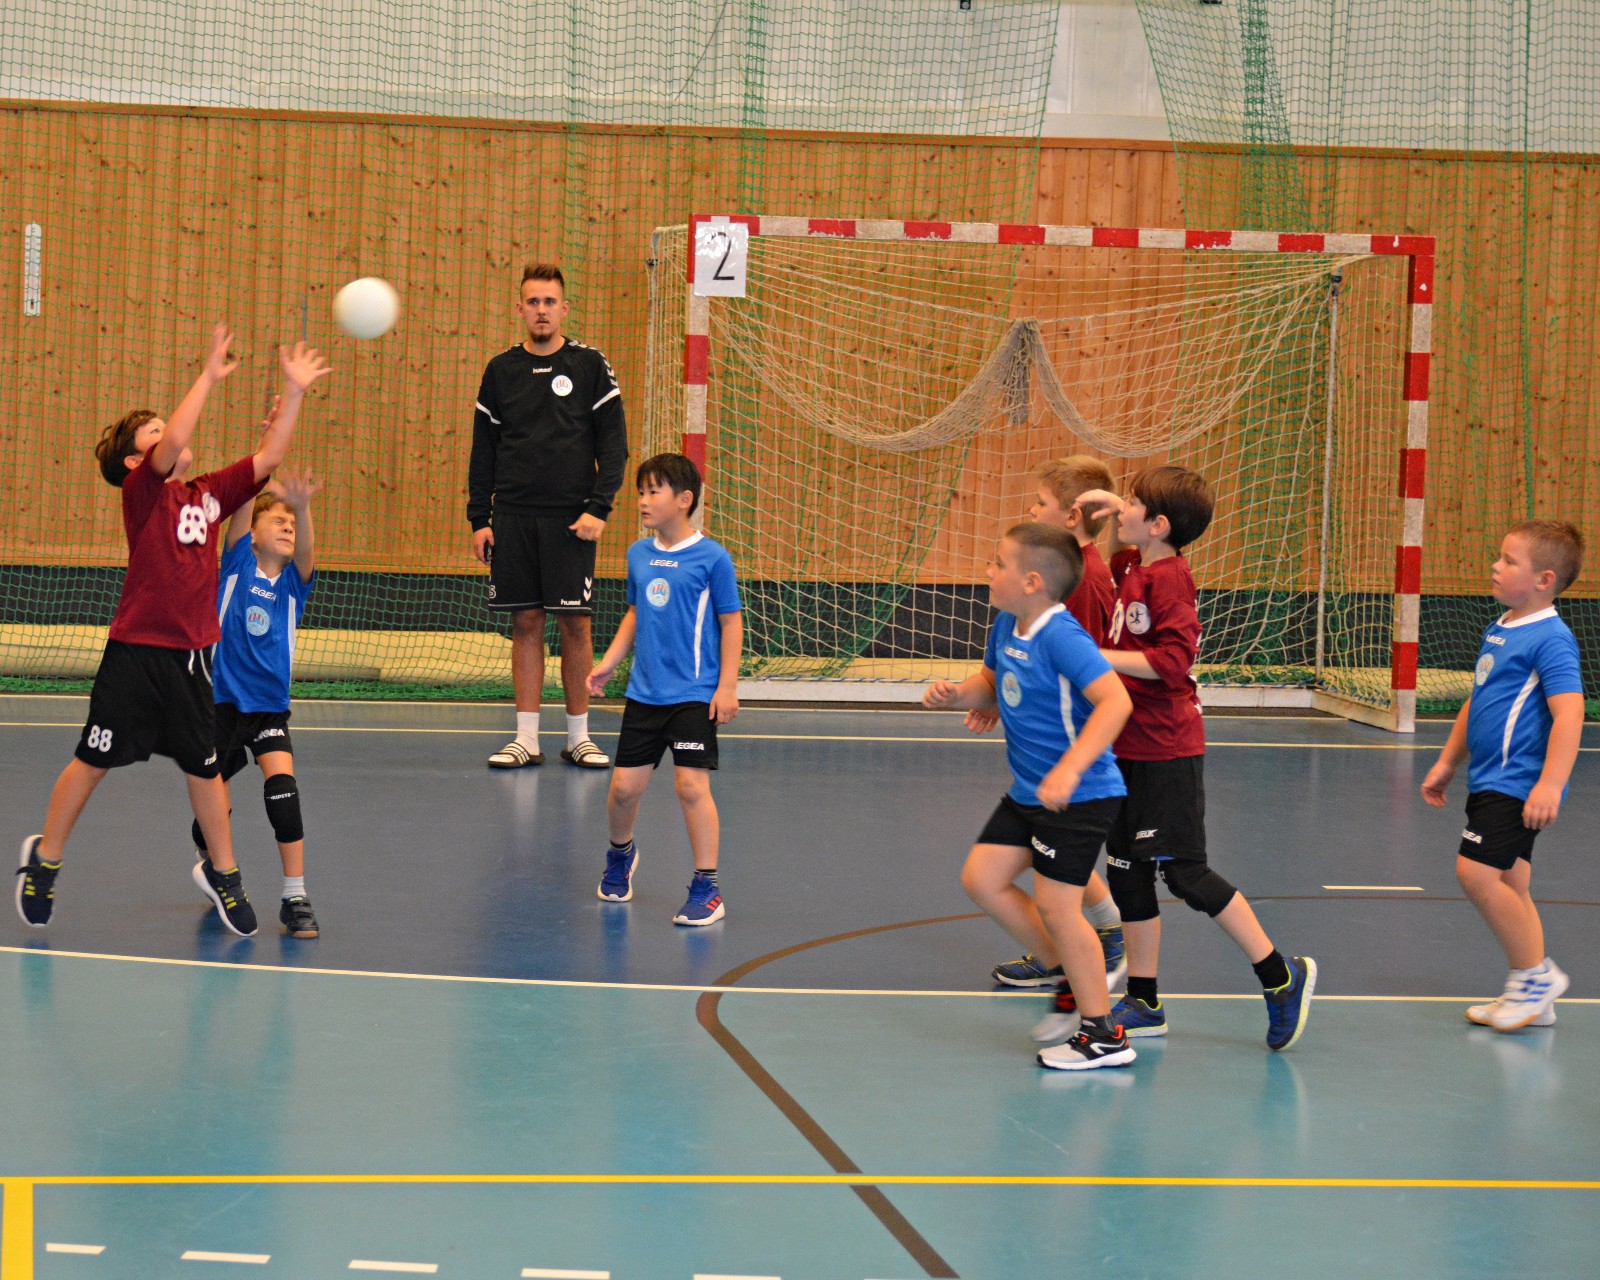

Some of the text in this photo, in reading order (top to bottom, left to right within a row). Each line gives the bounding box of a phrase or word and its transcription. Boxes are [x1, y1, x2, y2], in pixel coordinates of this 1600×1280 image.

[707, 231, 735, 281] 2
[649, 559, 679, 568] LEGEA
[250, 585, 277, 601] EGEA
[87, 724, 113, 753] 88
[673, 741, 705, 751] LEGEA
